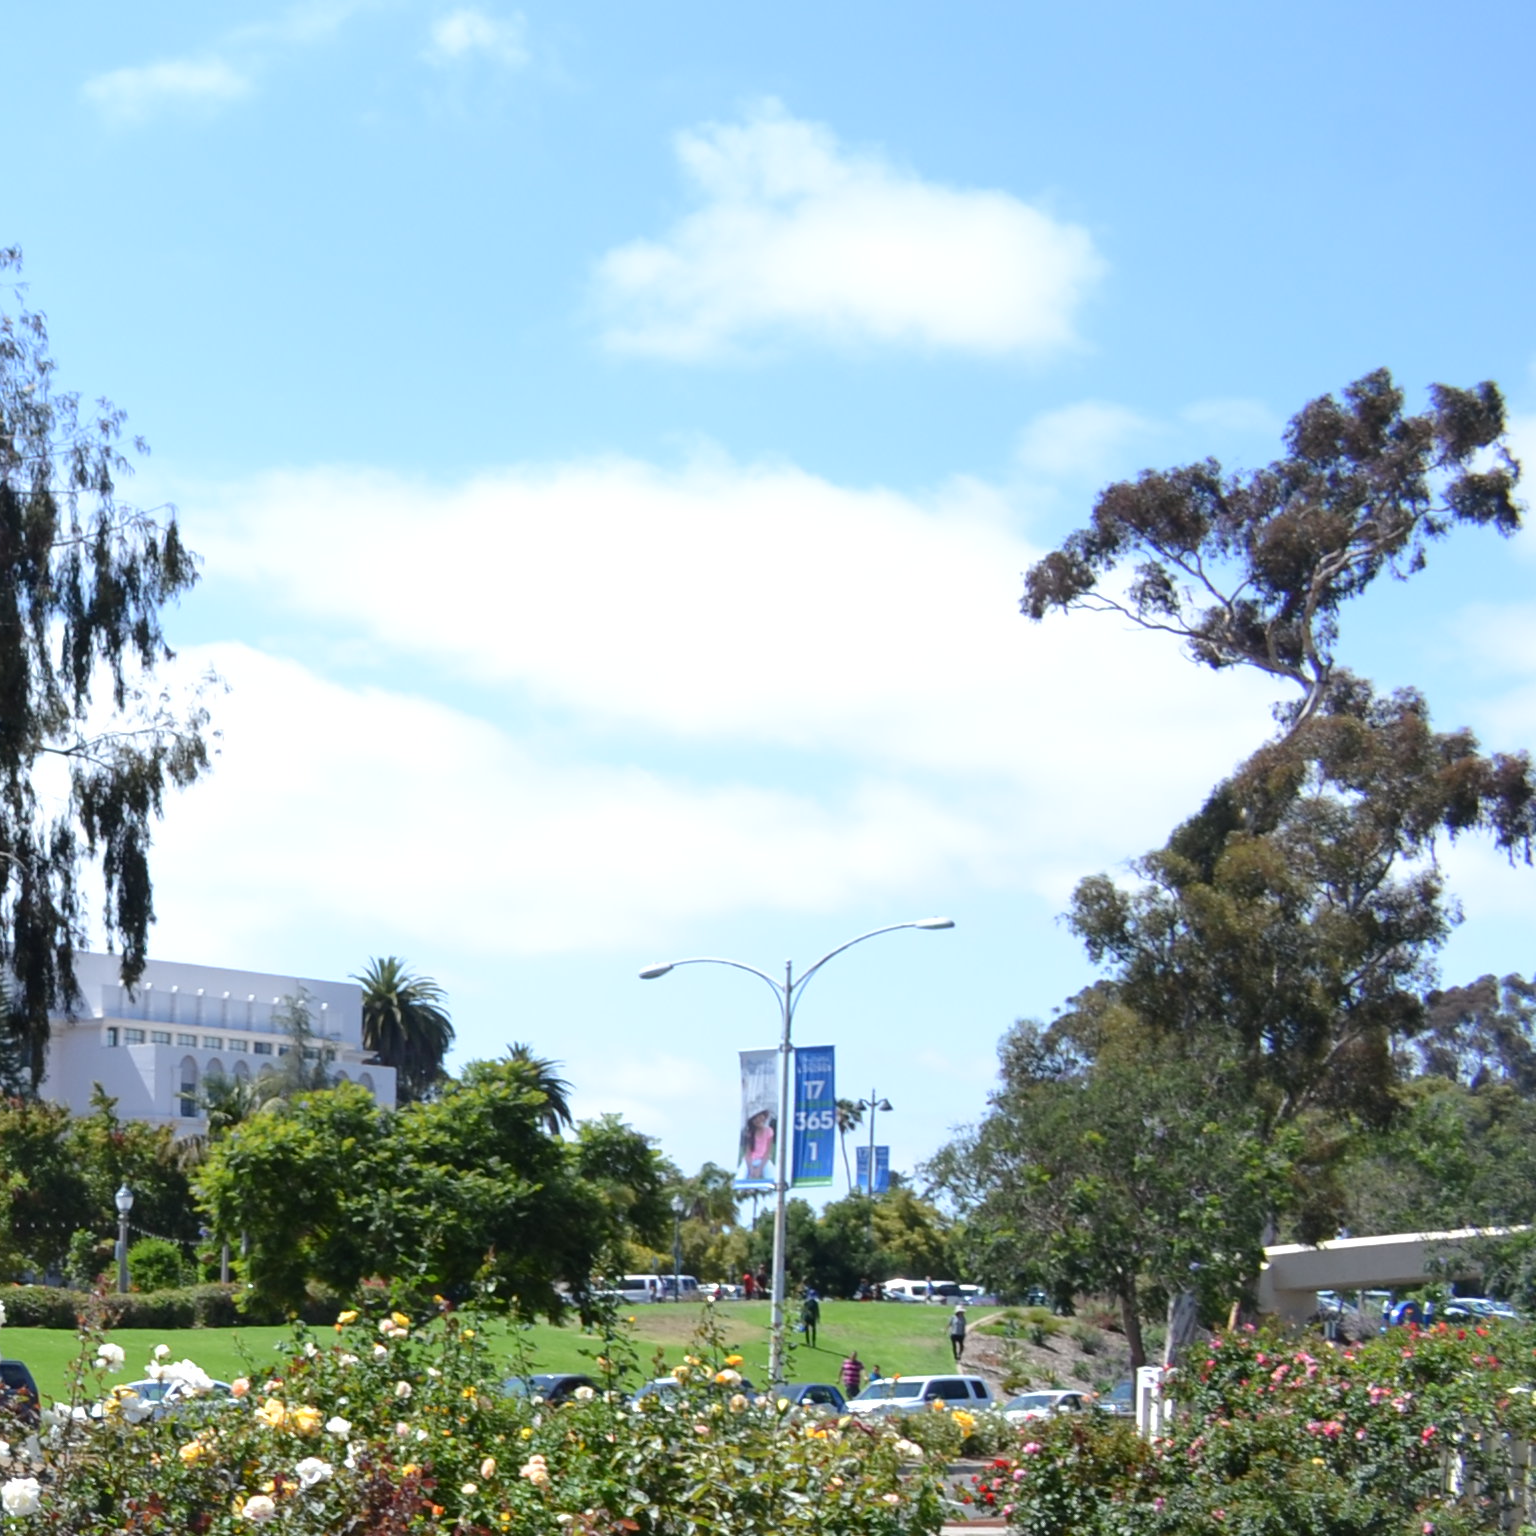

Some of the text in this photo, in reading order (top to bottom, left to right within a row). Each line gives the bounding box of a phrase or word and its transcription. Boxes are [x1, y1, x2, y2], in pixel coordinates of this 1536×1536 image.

[803, 1081, 825, 1099] 17
[794, 1110, 834, 1131] 365
[808, 1142, 817, 1161] 1
